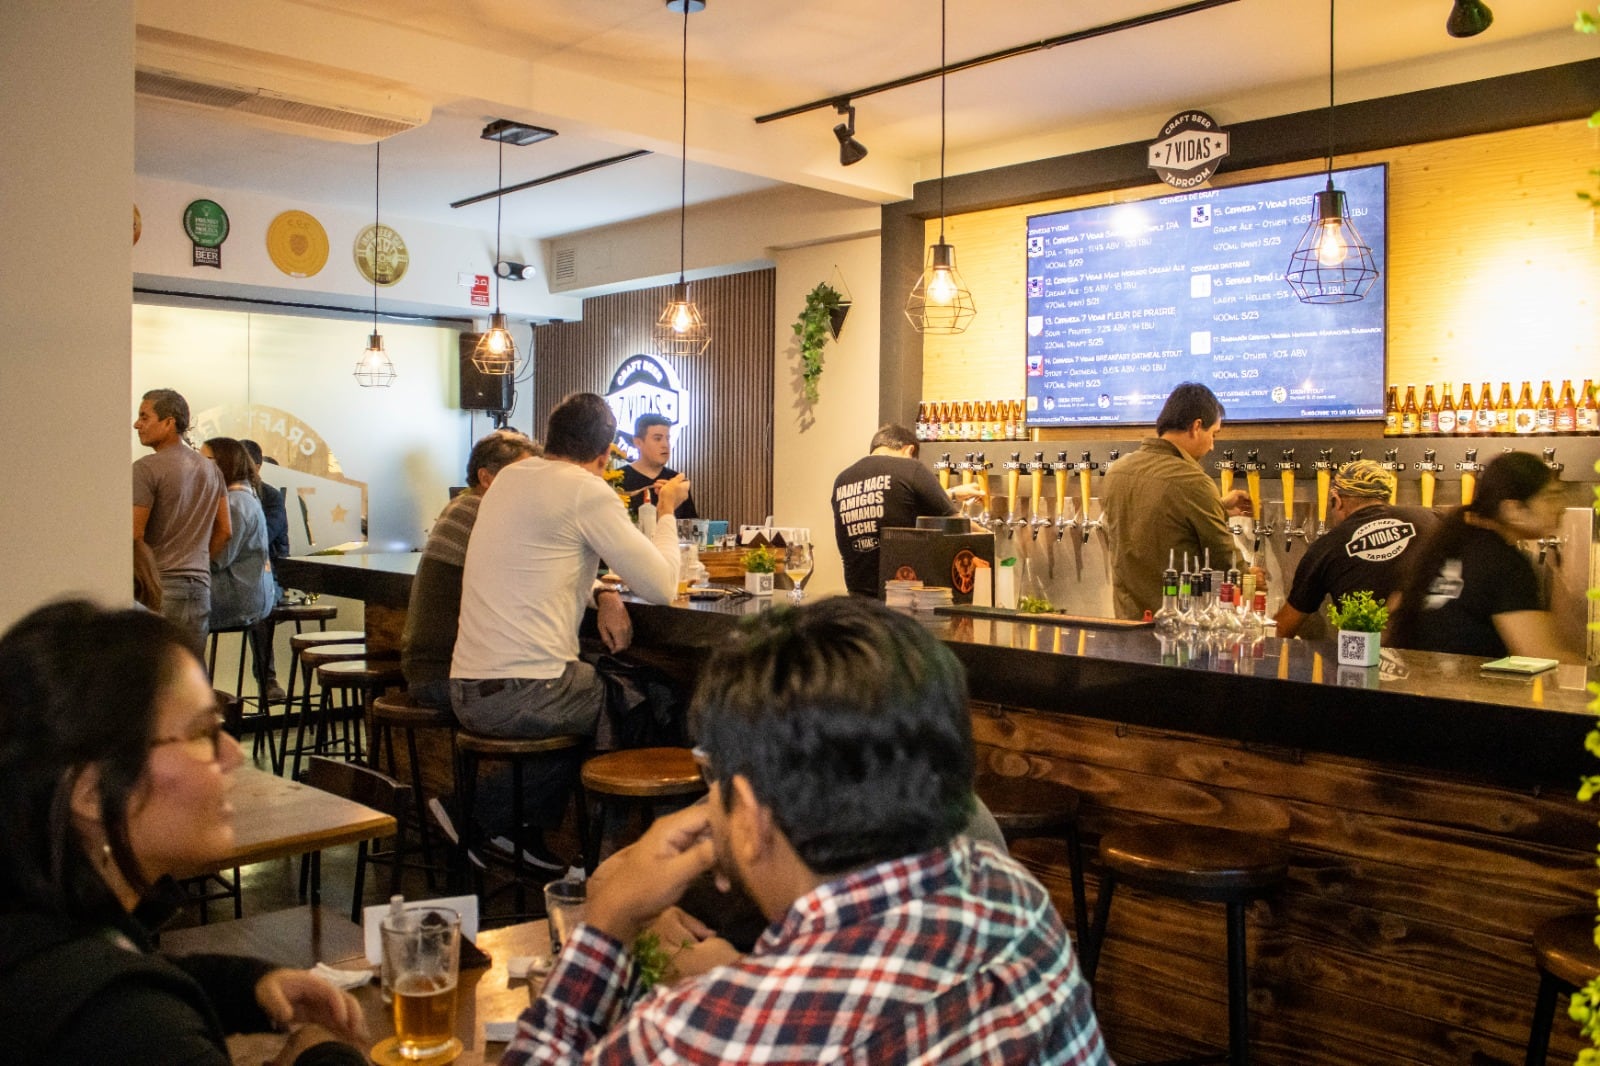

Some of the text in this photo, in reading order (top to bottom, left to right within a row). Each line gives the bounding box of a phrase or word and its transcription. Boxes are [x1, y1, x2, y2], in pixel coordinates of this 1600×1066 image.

[1165, 114, 1211, 134] CRAFT BEER
[1165, 137, 1210, 165] 7 VIDAS
[1165, 167, 1210, 187] TAPROOM
[1258, 202, 1264, 211] 7
[1266, 199, 1287, 209] VIDAS
[1239, 223, 1253, 231] ALE
[1352, 208, 1368, 217] IBU
[1107, 311, 1131, 320] FLEUR
[1132, 310, 1142, 319] DE
[1291, 349, 1307, 358] ABV
[837, 481, 863, 501] NADIE
[840, 490, 884, 513] AMIGOS
[840, 504, 884, 525] TOMANDO
[847, 520, 878, 537] LECHE
[1360, 527, 1401, 550] 7 VIDAS
[1366, 545, 1403, 560] TAPROOM
